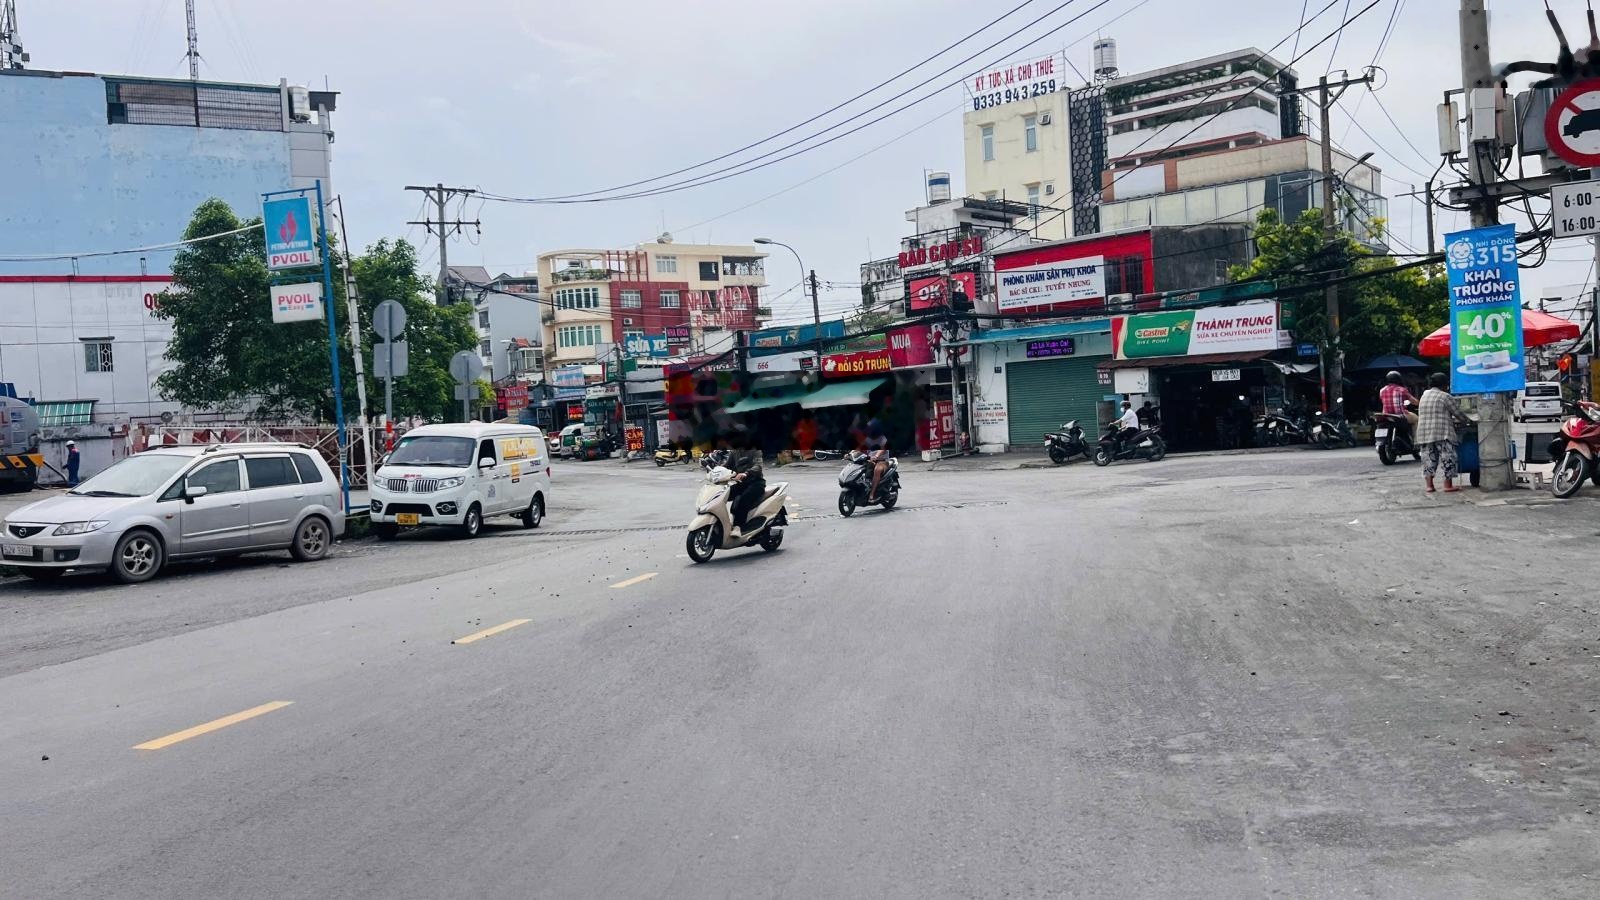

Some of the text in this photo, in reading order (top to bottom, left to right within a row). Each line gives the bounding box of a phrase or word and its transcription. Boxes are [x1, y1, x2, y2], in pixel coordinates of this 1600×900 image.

[1018, 63, 1032, 81] CHO
[1036, 56, 1054, 77] THUÊ
[973, 92, 1002, 111] 0333
[1564, 192, 1591, 208] 6:00
[1562, 216, 1595, 232] 16:00
[1491, 237, 1515, 246] ĐỒNG
[272, 252, 310, 266] PVOIL
[898, 236, 983, 269] BAO CAO SU
[1476, 244, 1515, 265] 315
[1003, 265, 1097, 286] PHÒNG KHÁM SẢN PHỤ KHOA
[1464, 268, 1501, 283] KHAI
[919, 283, 941, 300] OK
[1009, 287, 1021, 297] BÁC
[1021, 286, 1028, 295] SĨ
[1045, 282, 1066, 292] TUYẾT
[1068, 279, 1091, 289] NHUNG
[1453, 281, 1516, 297] TRƯƠNG
[278, 293, 313, 306] PVOIL
[687, 285, 753, 311] NHA KHOA
[1456, 294, 1512, 306] PHÒNG KHÁM
[713, 310, 744, 326] MINH
[1196, 315, 1274, 331] THÀNH TRUNG
[1143, 329, 1167, 337] Castrol
[1220, 329, 1247, 337] CHUYÊN
[1248, 327, 1273, 336] NGHIỆP
[627, 337, 668, 353] SỬA XE
[891, 334, 911, 350] MUA
[757, 361, 769, 370] 666
[852, 356, 864, 371] SỐ
[865, 355, 890, 371] TRÚN
